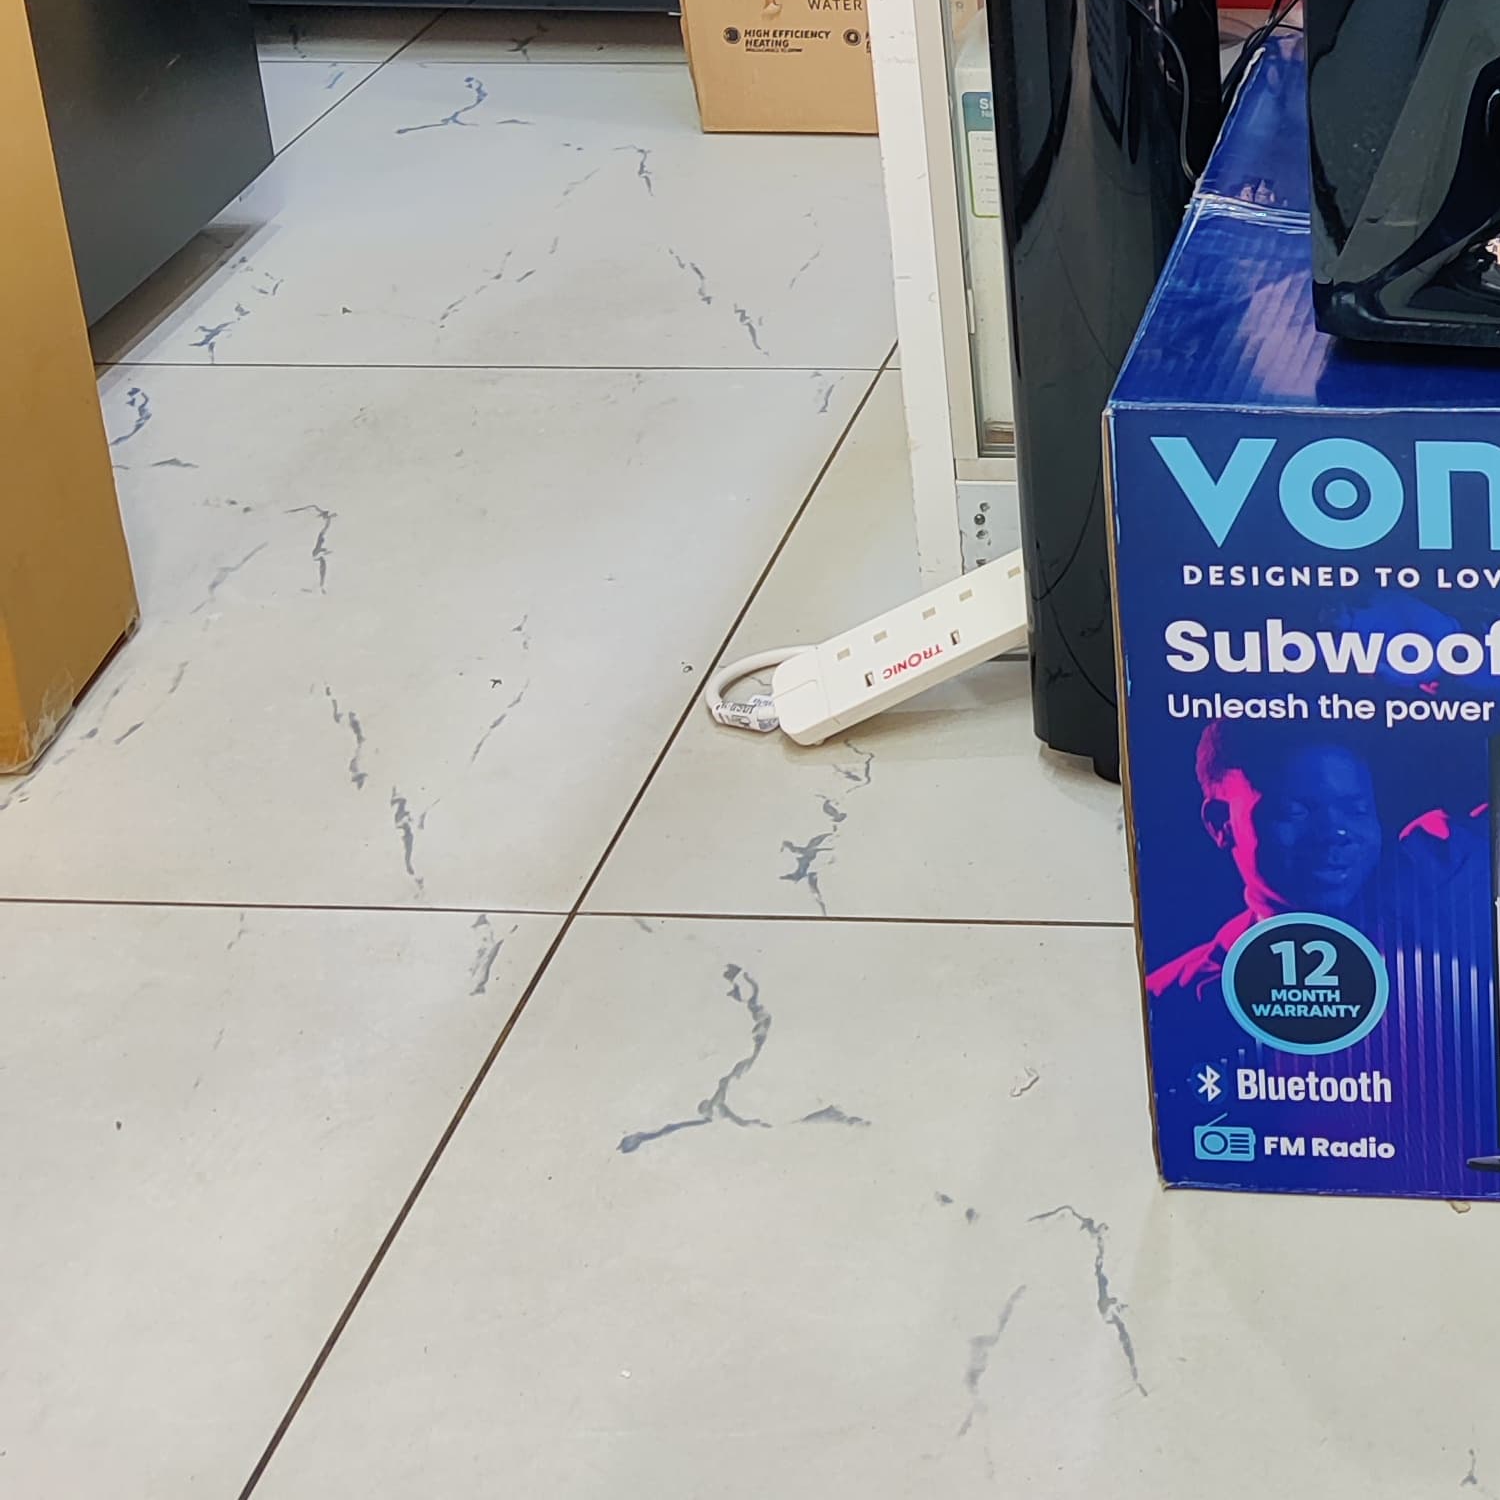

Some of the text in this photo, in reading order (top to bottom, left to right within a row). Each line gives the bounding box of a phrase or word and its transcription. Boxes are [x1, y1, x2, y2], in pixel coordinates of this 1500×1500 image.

[744, 29, 831, 39] HIGH EFFICIENCY
[745, 39, 789, 48] HEATING
[1183, 564, 1360, 587] DESIGNED
[1375, 567, 1421, 588] TO
[882, 644, 943, 680] TRONIC
[1168, 694, 1308, 719] Unleash
[1318, 695, 1376, 720] the
[1386, 698, 1494, 728] power
[1270, 940, 1339, 986] 12
[1271, 989, 1340, 1002] MONTH
[1252, 1004, 1360, 1018] WARRANTY
[1237, 1069, 1392, 1102] Bluetooth
[1264, 1137, 1395, 1158] FM Radio
